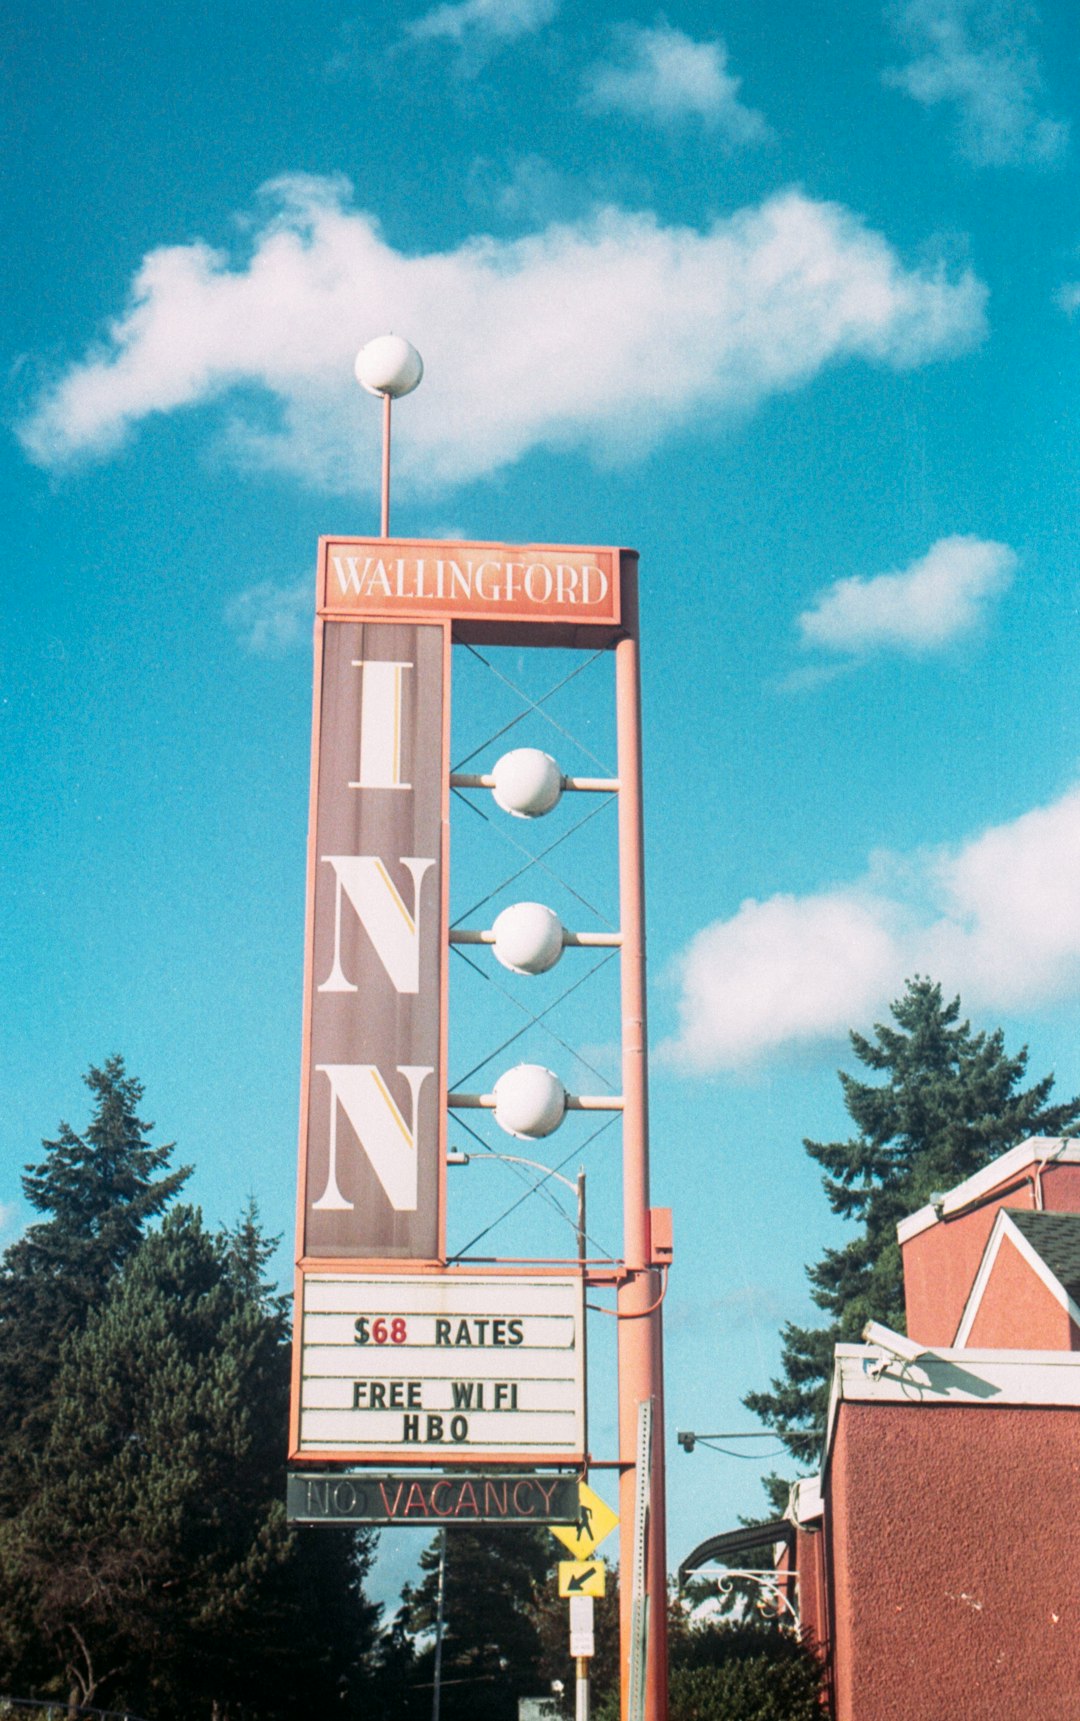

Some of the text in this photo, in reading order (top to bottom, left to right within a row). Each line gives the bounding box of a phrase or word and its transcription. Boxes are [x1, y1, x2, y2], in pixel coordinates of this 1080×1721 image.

[332, 556, 608, 605] WALLINGFORD
[312, 660, 436, 1212] INN
[353, 1316, 524, 1346] $68 RATES
[352, 1381, 423, 1408] FREE
[402, 1413, 469, 1442] HBO
[306, 1479, 558, 1517] NO VACANCY
